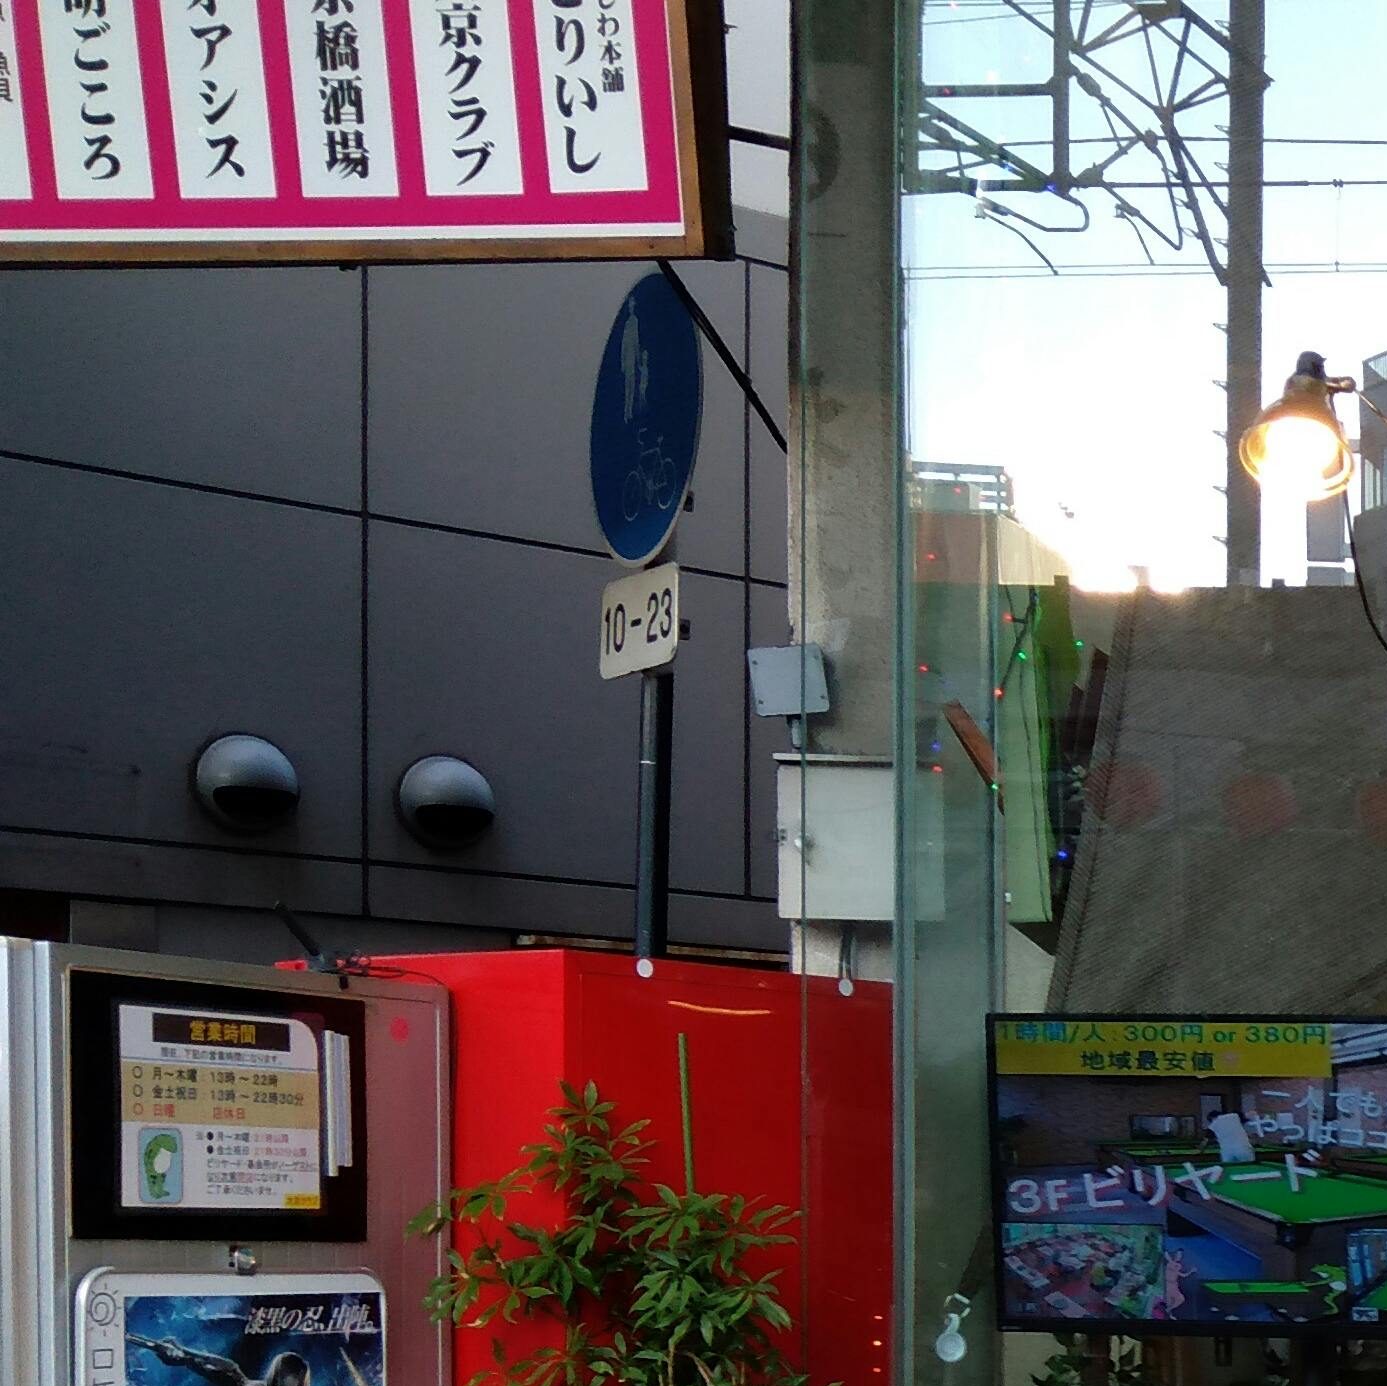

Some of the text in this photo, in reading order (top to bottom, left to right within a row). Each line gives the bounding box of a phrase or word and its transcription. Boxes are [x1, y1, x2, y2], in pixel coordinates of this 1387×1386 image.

[604, 586, 674, 657] 10-23
[189, 1020, 256, 1045] 営業時間
[1125, 1025, 1328, 1046] 300円 or 380円
[1080, 1049, 1216, 1073] 地域最安値
[153, 1103, 176, 1119] 日曜
[1008, 1148, 1319, 1215] 3F ビリヤード
